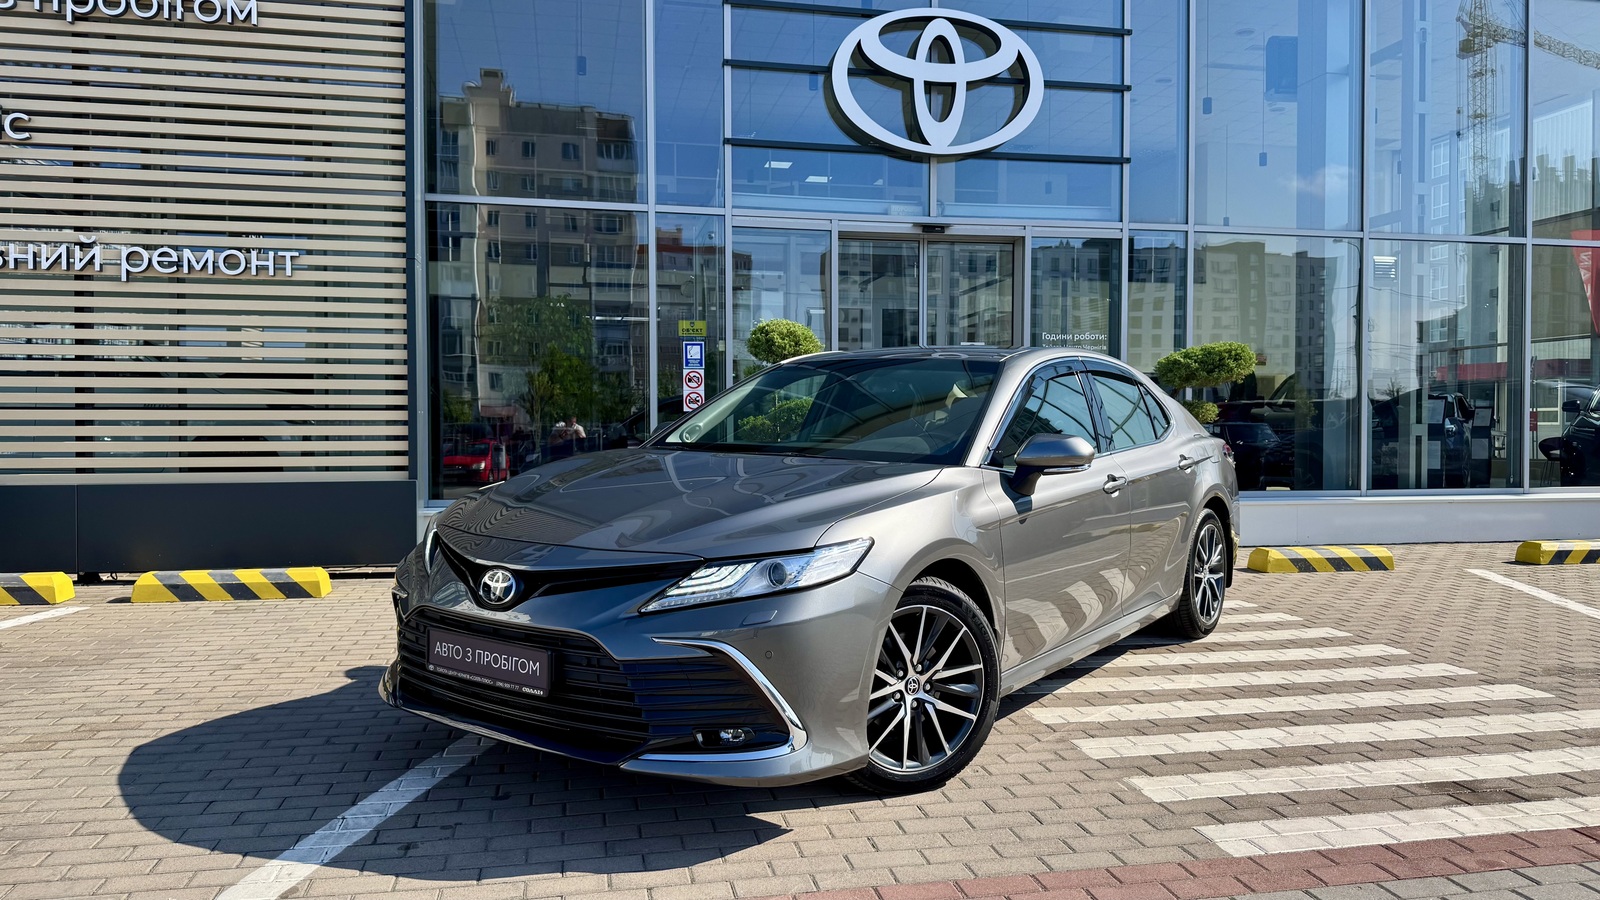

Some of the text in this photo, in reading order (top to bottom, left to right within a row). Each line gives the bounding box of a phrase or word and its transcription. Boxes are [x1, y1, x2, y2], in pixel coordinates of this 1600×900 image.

[121, 247, 299, 282] ремонт
[1042, 332, 1107, 341] Години роботи:
[434, 642, 462, 659] АВТО
[476, 650, 540, 676] ПРОБІГОМ
